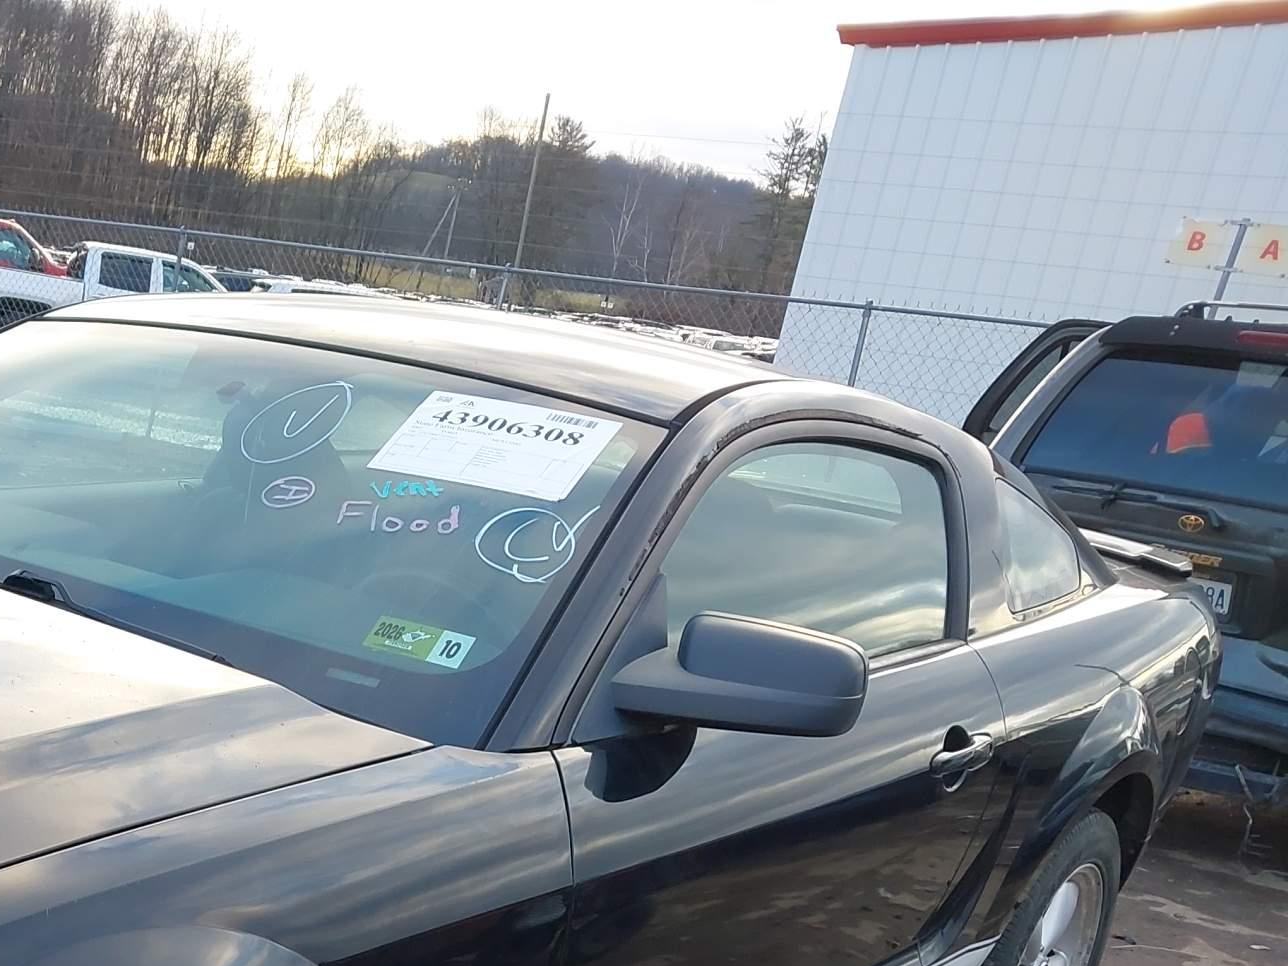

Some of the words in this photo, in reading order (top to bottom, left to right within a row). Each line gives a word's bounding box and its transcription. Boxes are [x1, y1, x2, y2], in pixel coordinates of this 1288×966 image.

[1187, 231, 1206, 251] B
[1259, 239, 1279, 261] A
[431, 408, 585, 447] 43906308
[337, 500, 460, 534] Flood
[374, 621, 406, 642] 2026
[439, 639, 462, 660] 10
